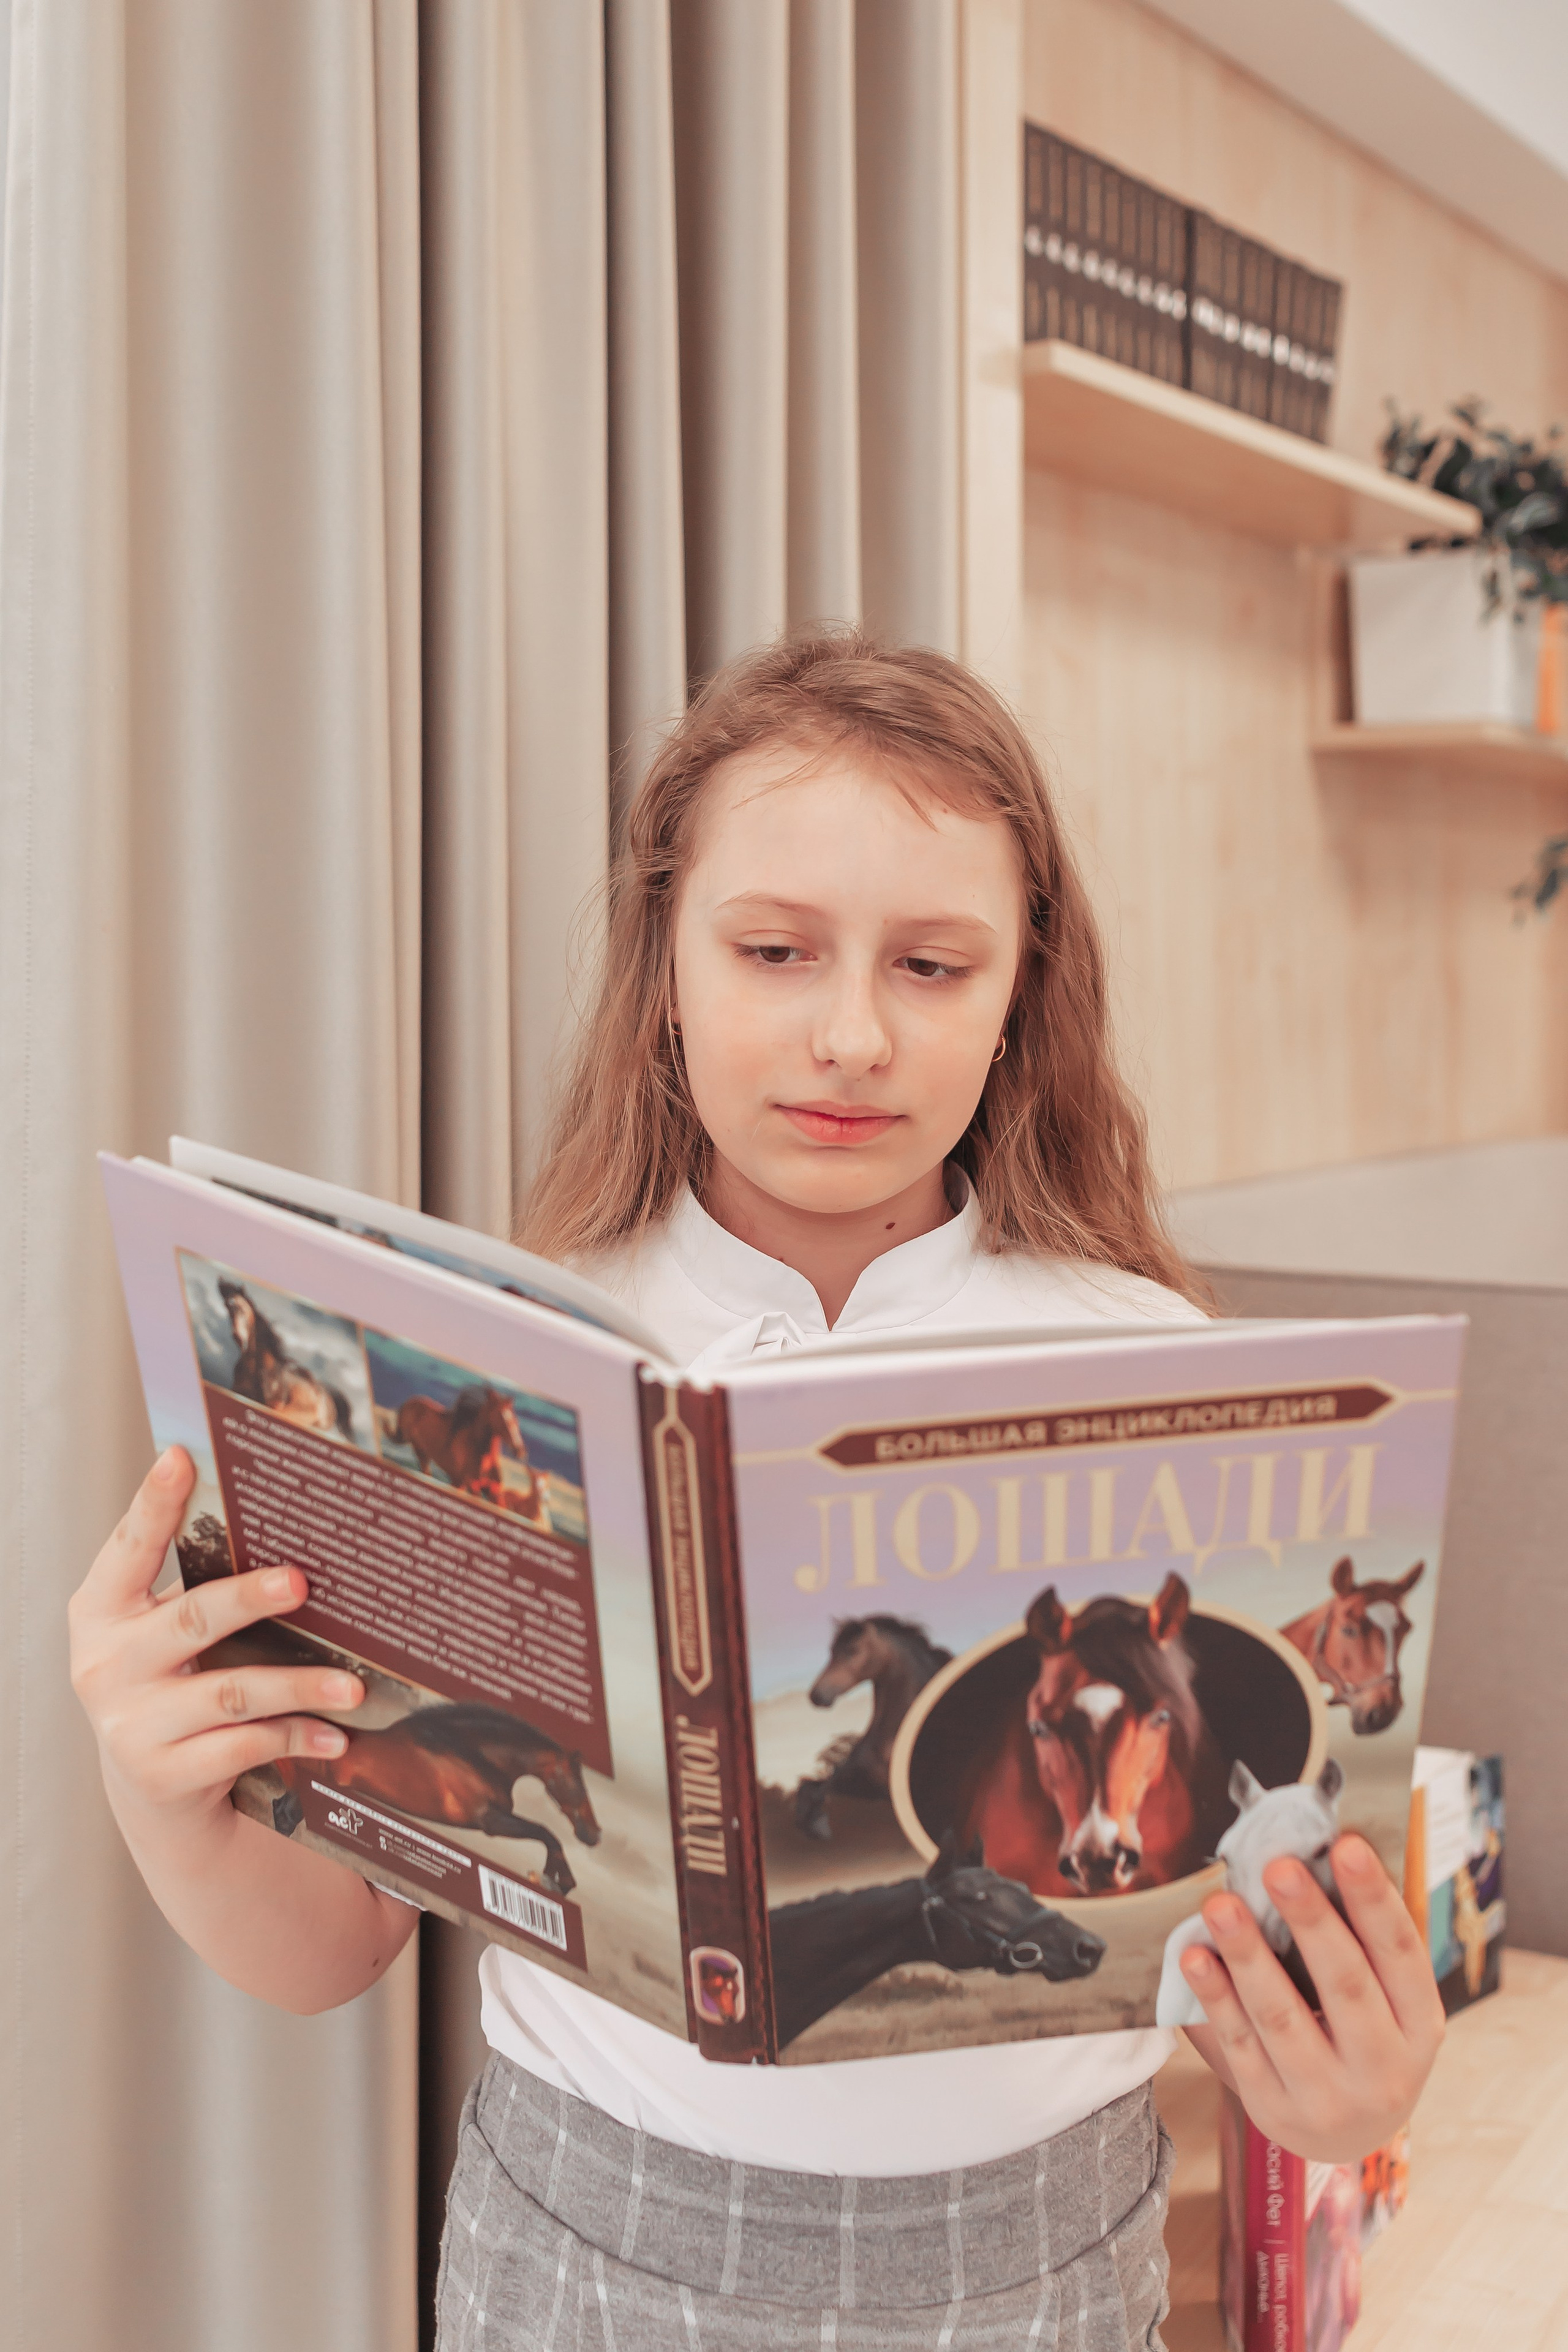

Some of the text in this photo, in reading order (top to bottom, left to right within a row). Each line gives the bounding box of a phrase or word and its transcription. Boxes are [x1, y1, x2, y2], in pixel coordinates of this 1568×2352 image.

[875, 1395, 1338, 1461] БОЛЬШАЯ ЭНЦИКЛОПЕДИЯ
[794, 1444, 1385, 1593] ЛОШАДИ
[675, 1715, 727, 1877] ЛОШАДИ
[1266, 2193, 1285, 2227] Фет
